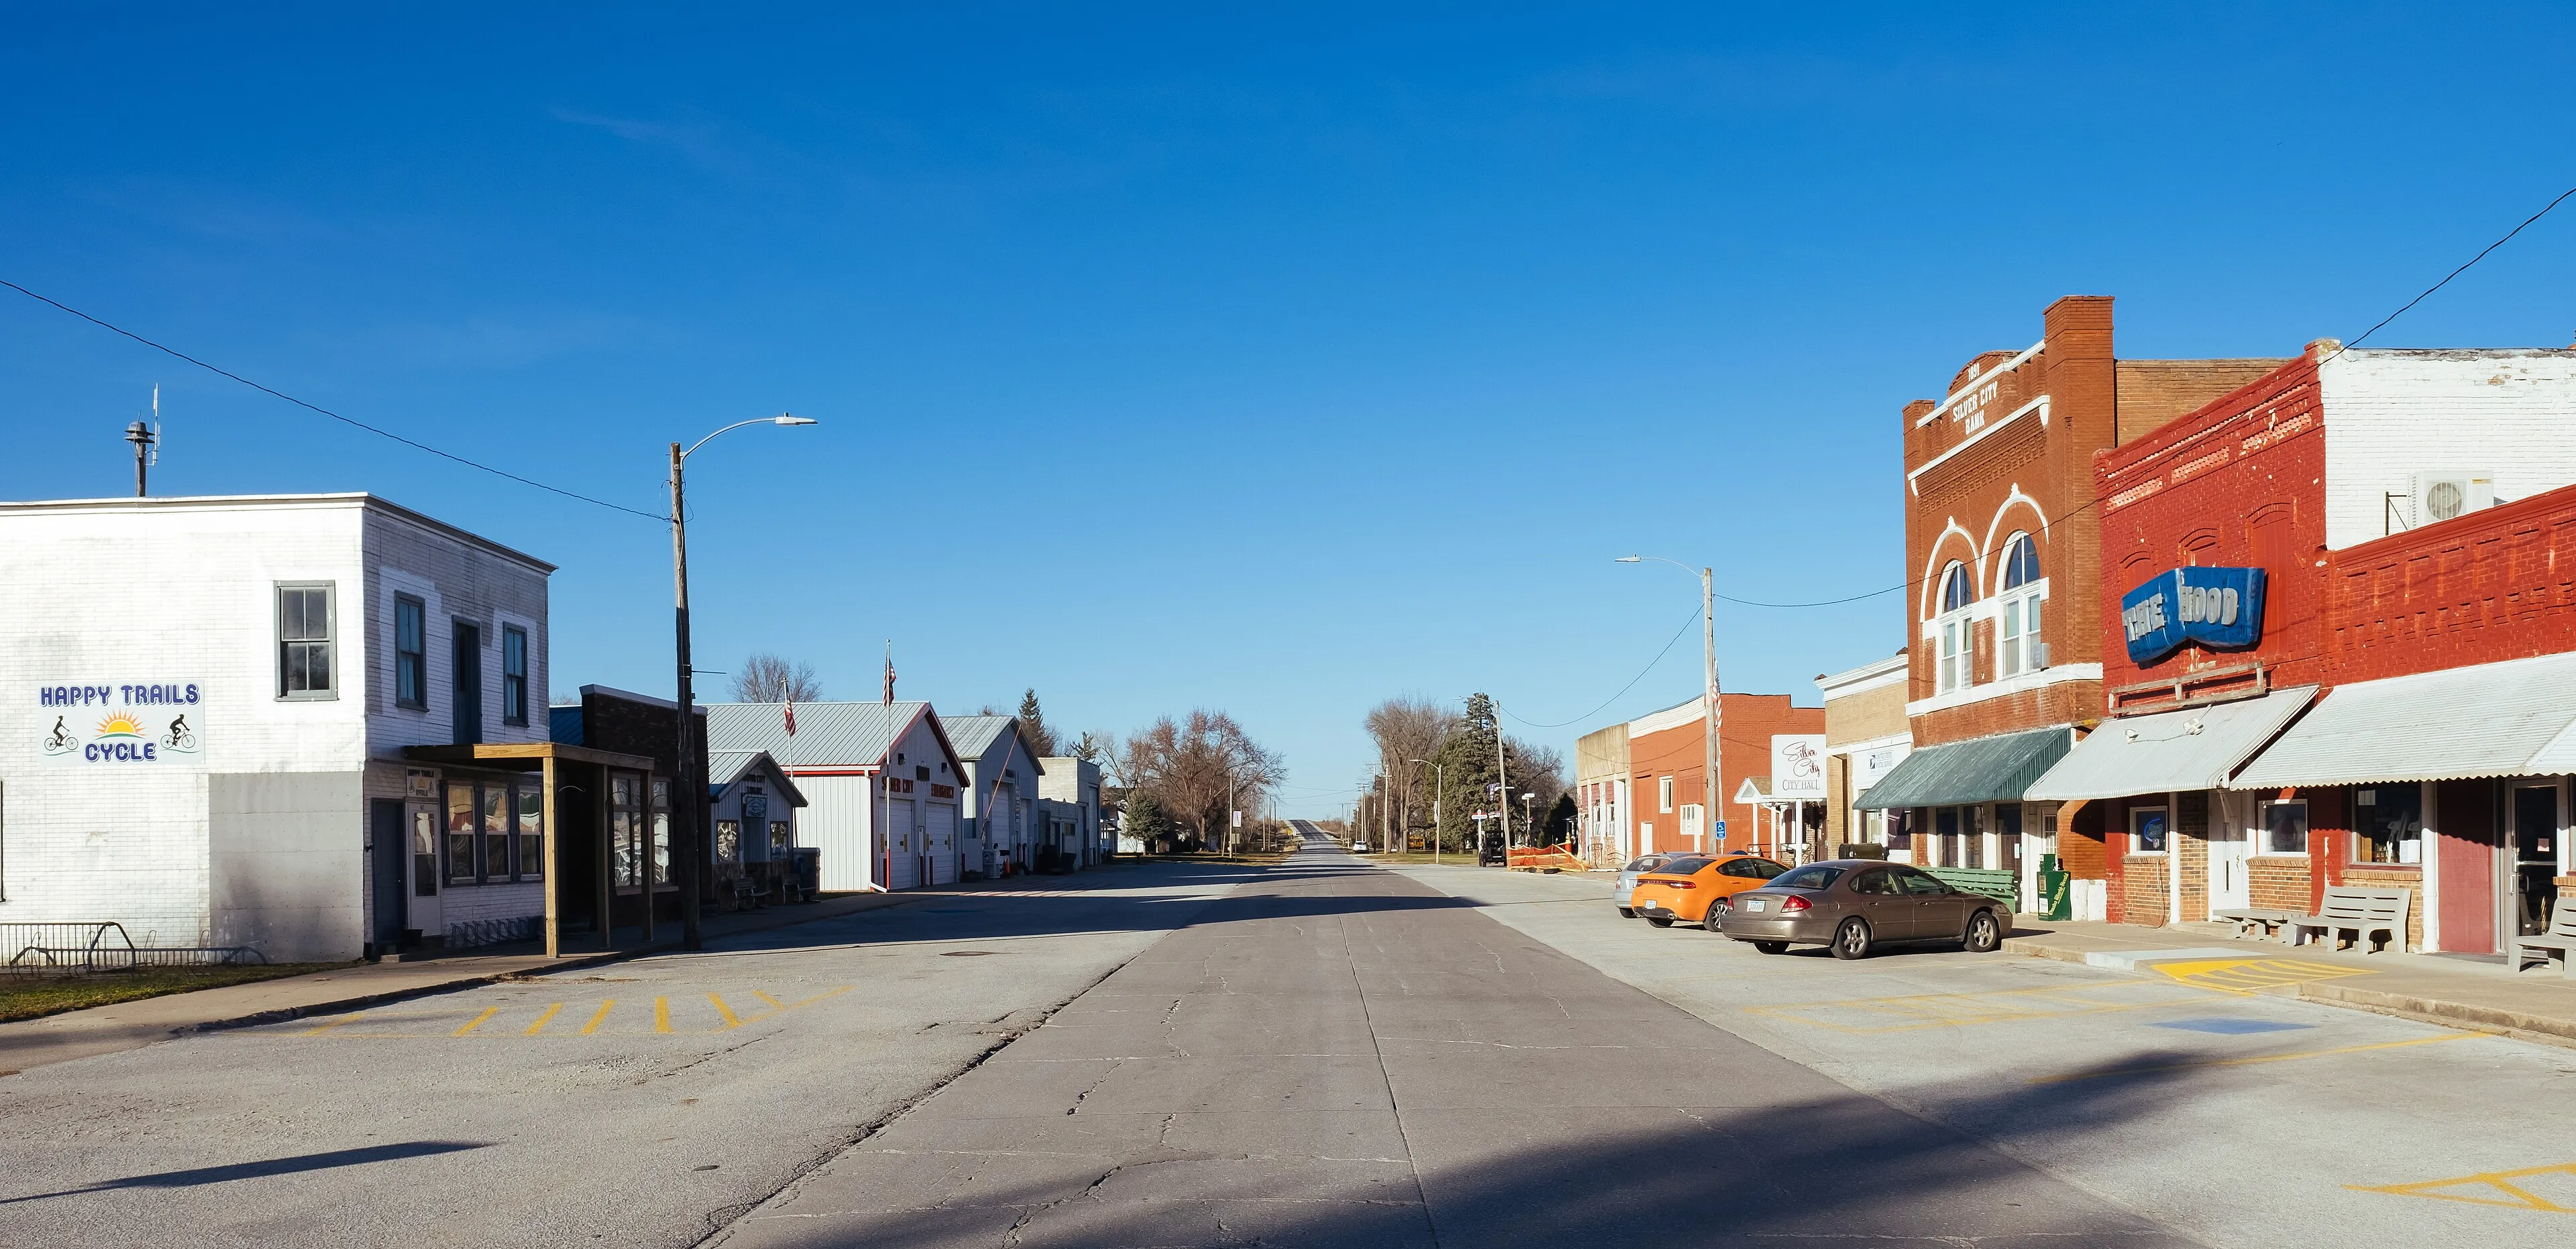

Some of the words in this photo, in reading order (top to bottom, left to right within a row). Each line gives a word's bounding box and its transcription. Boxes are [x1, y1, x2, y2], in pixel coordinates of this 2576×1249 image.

[1968, 362, 1980, 382] 1891
[1953, 394, 1978, 423] SILVER
[1980, 380, 1998, 406] CITY
[1965, 409, 1985, 435] BANK
[2122, 593, 2166, 642] THE
[2179, 586, 2239, 625] HOOD
[40, 685, 112, 707] HAPPY
[120, 683, 201, 706] TRAILS
[85, 741, 158, 763] CYCLE
